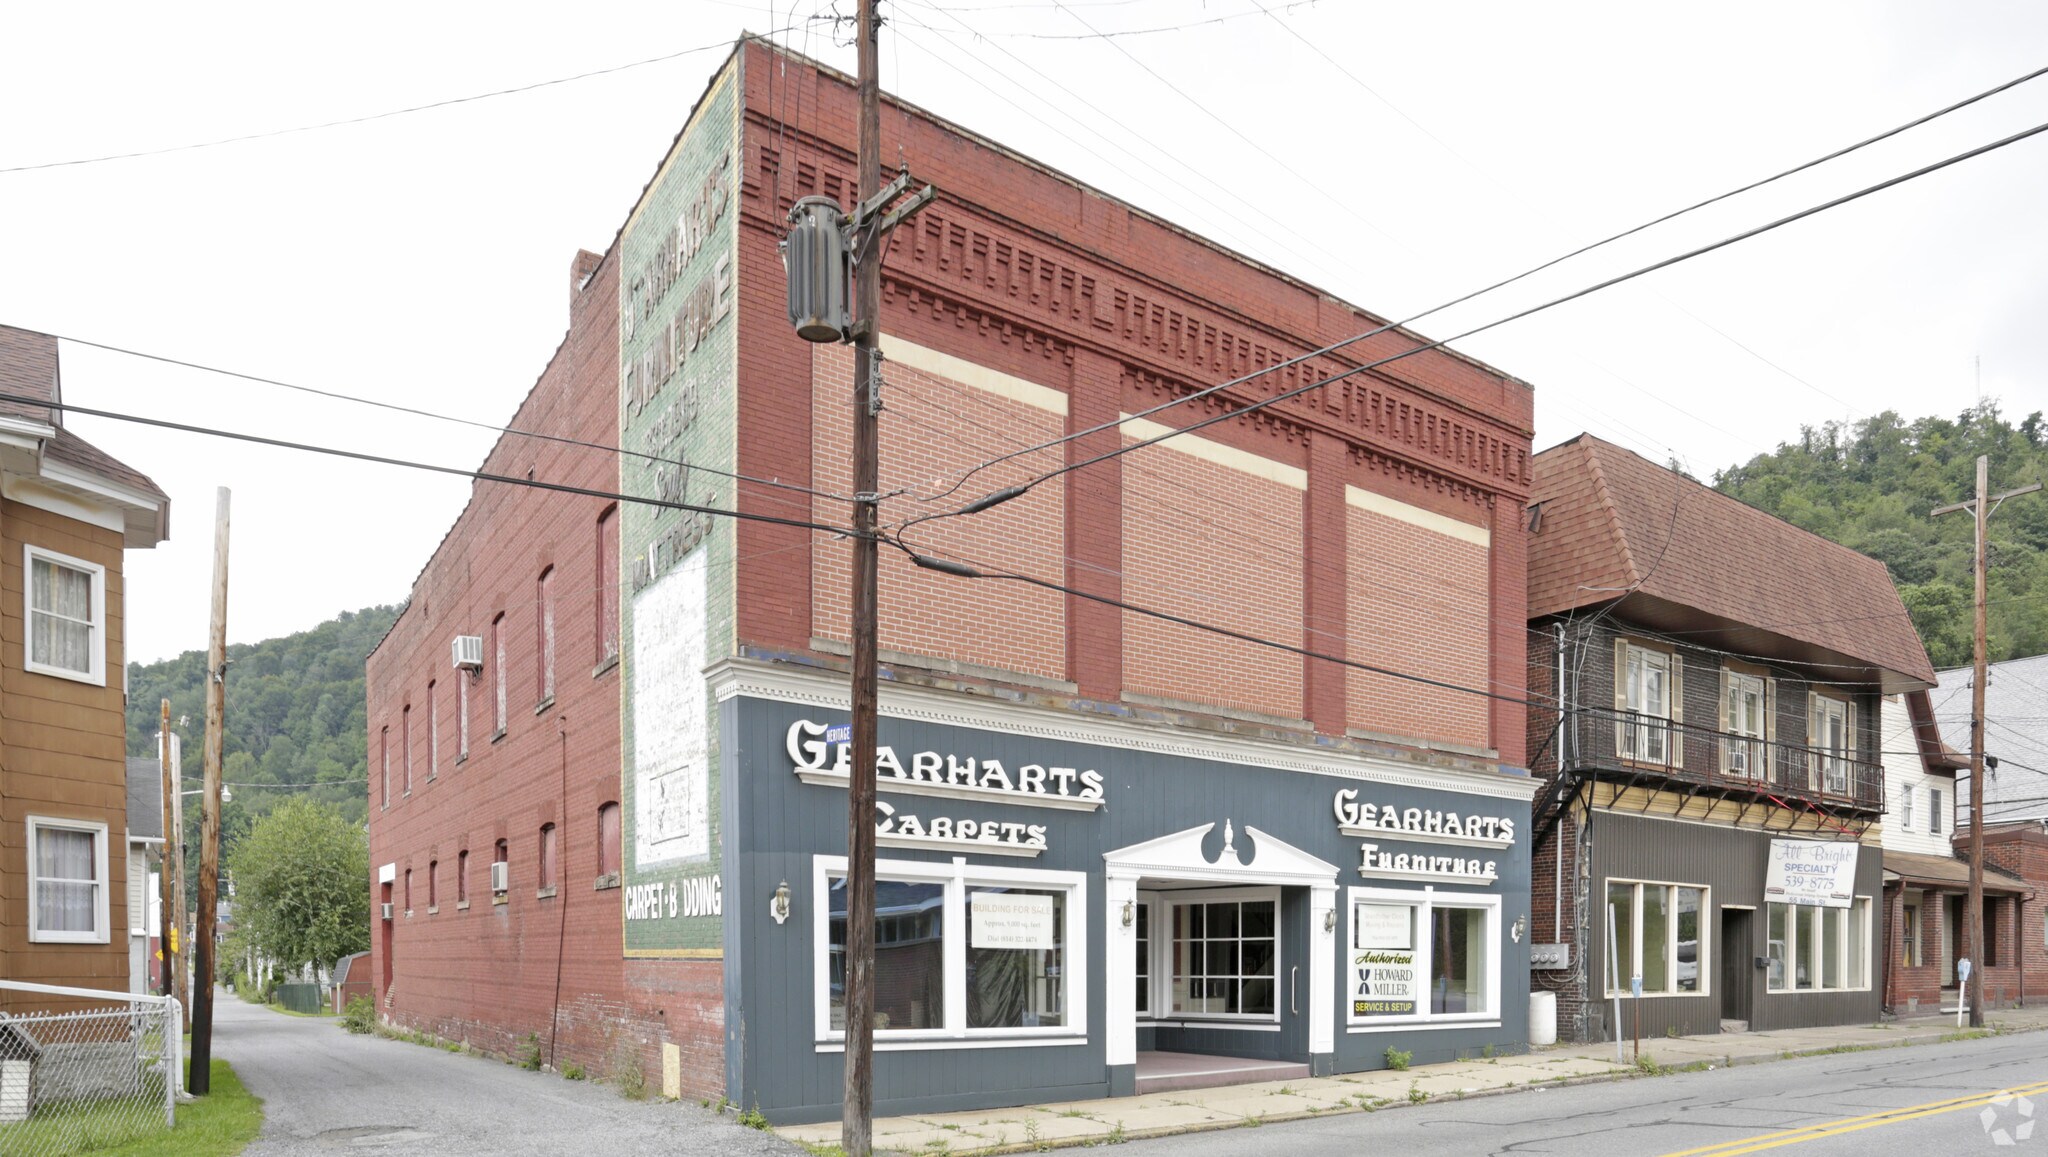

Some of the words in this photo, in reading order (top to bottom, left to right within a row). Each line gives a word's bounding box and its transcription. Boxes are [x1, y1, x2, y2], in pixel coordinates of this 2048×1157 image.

[624, 249, 730, 432] FURNITURE
[1334, 789, 1515, 840] GEARHARTS
[1361, 843, 1497, 876] FURNITURE
[1784, 863, 1838, 874] SPECIALTY
[1784, 876, 1835, 889] 539-8775
[1800, 897, 1816, 905] Main
[973, 904, 1011, 913] BUILDING
[1013, 905, 1029, 914] FOR
[1031, 905, 1051, 915] SALE
[1355, 951, 1413, 964] Authorized
[1374, 968, 1413, 981] HOWARD
[1373, 983, 1408, 996] MILLER
[1355, 1002, 1384, 1012] SERVICE
[1384, 1002, 1390, 1011] &
[1391, 1002, 1413, 1011] SETUP
